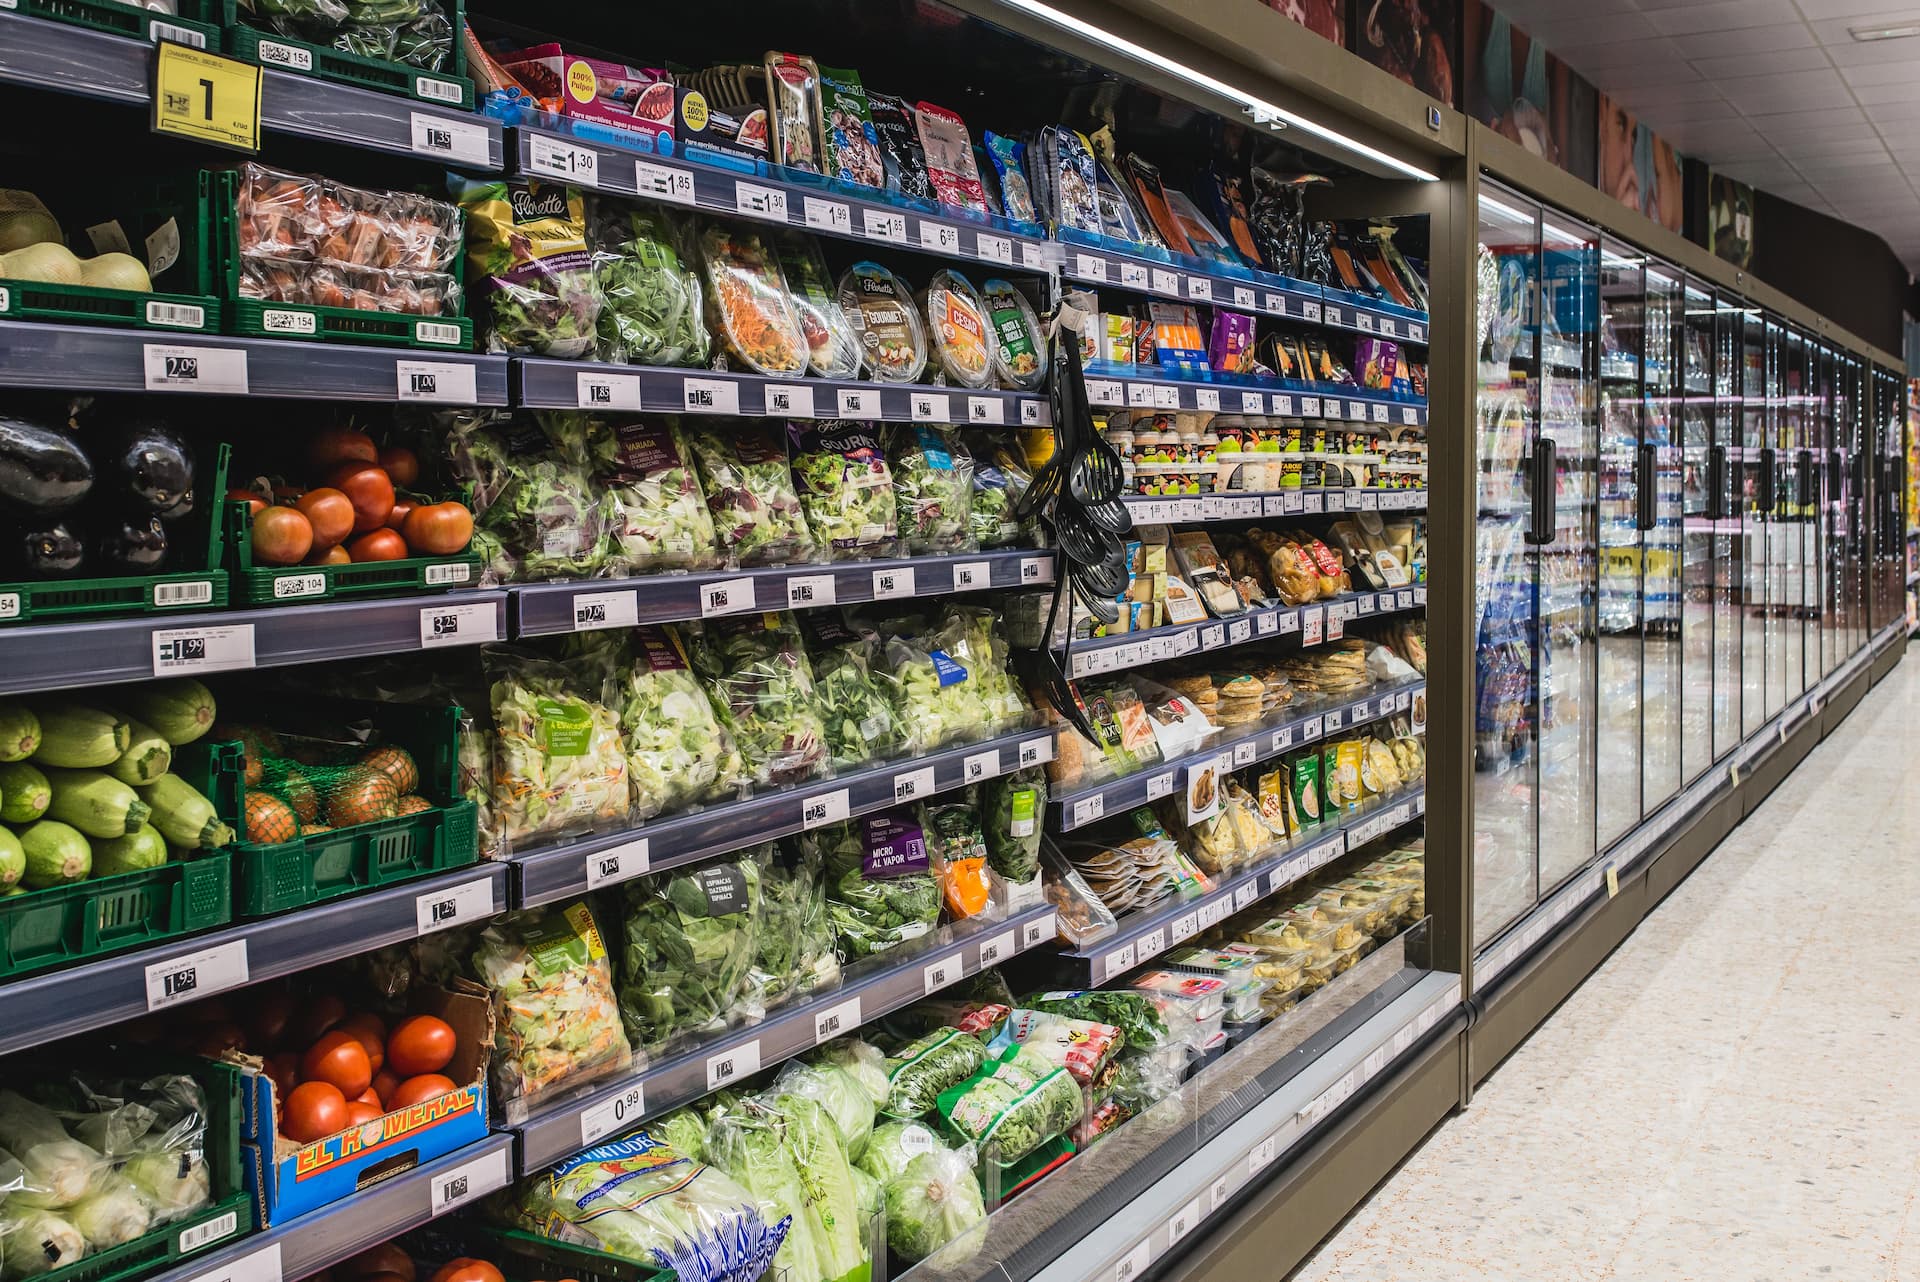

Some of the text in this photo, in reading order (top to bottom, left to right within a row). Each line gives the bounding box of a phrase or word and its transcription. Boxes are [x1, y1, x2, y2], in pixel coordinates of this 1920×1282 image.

[294, 52, 309, 64] 154
[572, 71, 593, 83] 100%
[571, 81, 593, 92] Pulpos
[199, 78, 214, 121] 1
[567, 151, 593, 173] 1,30
[667, 173, 690, 195] 1,85
[513, 190, 565, 216] Florette
[764, 193, 784, 212] 1,30
[863, 279, 895, 295] Florette
[297, 316, 313, 327] 154
[869, 311, 904, 324] GOURMET
[626, 439, 657, 451] VARIADA
[307, 579, 322, 591] 104
[872, 846, 894, 859] MICRO
[872, 854, 905, 869] AL VAPOR
[706, 877, 732, 887] ESPINACAS
[615, 1090, 639, 1121] 0,99
[341, 1090, 476, 1158] RMERAL
